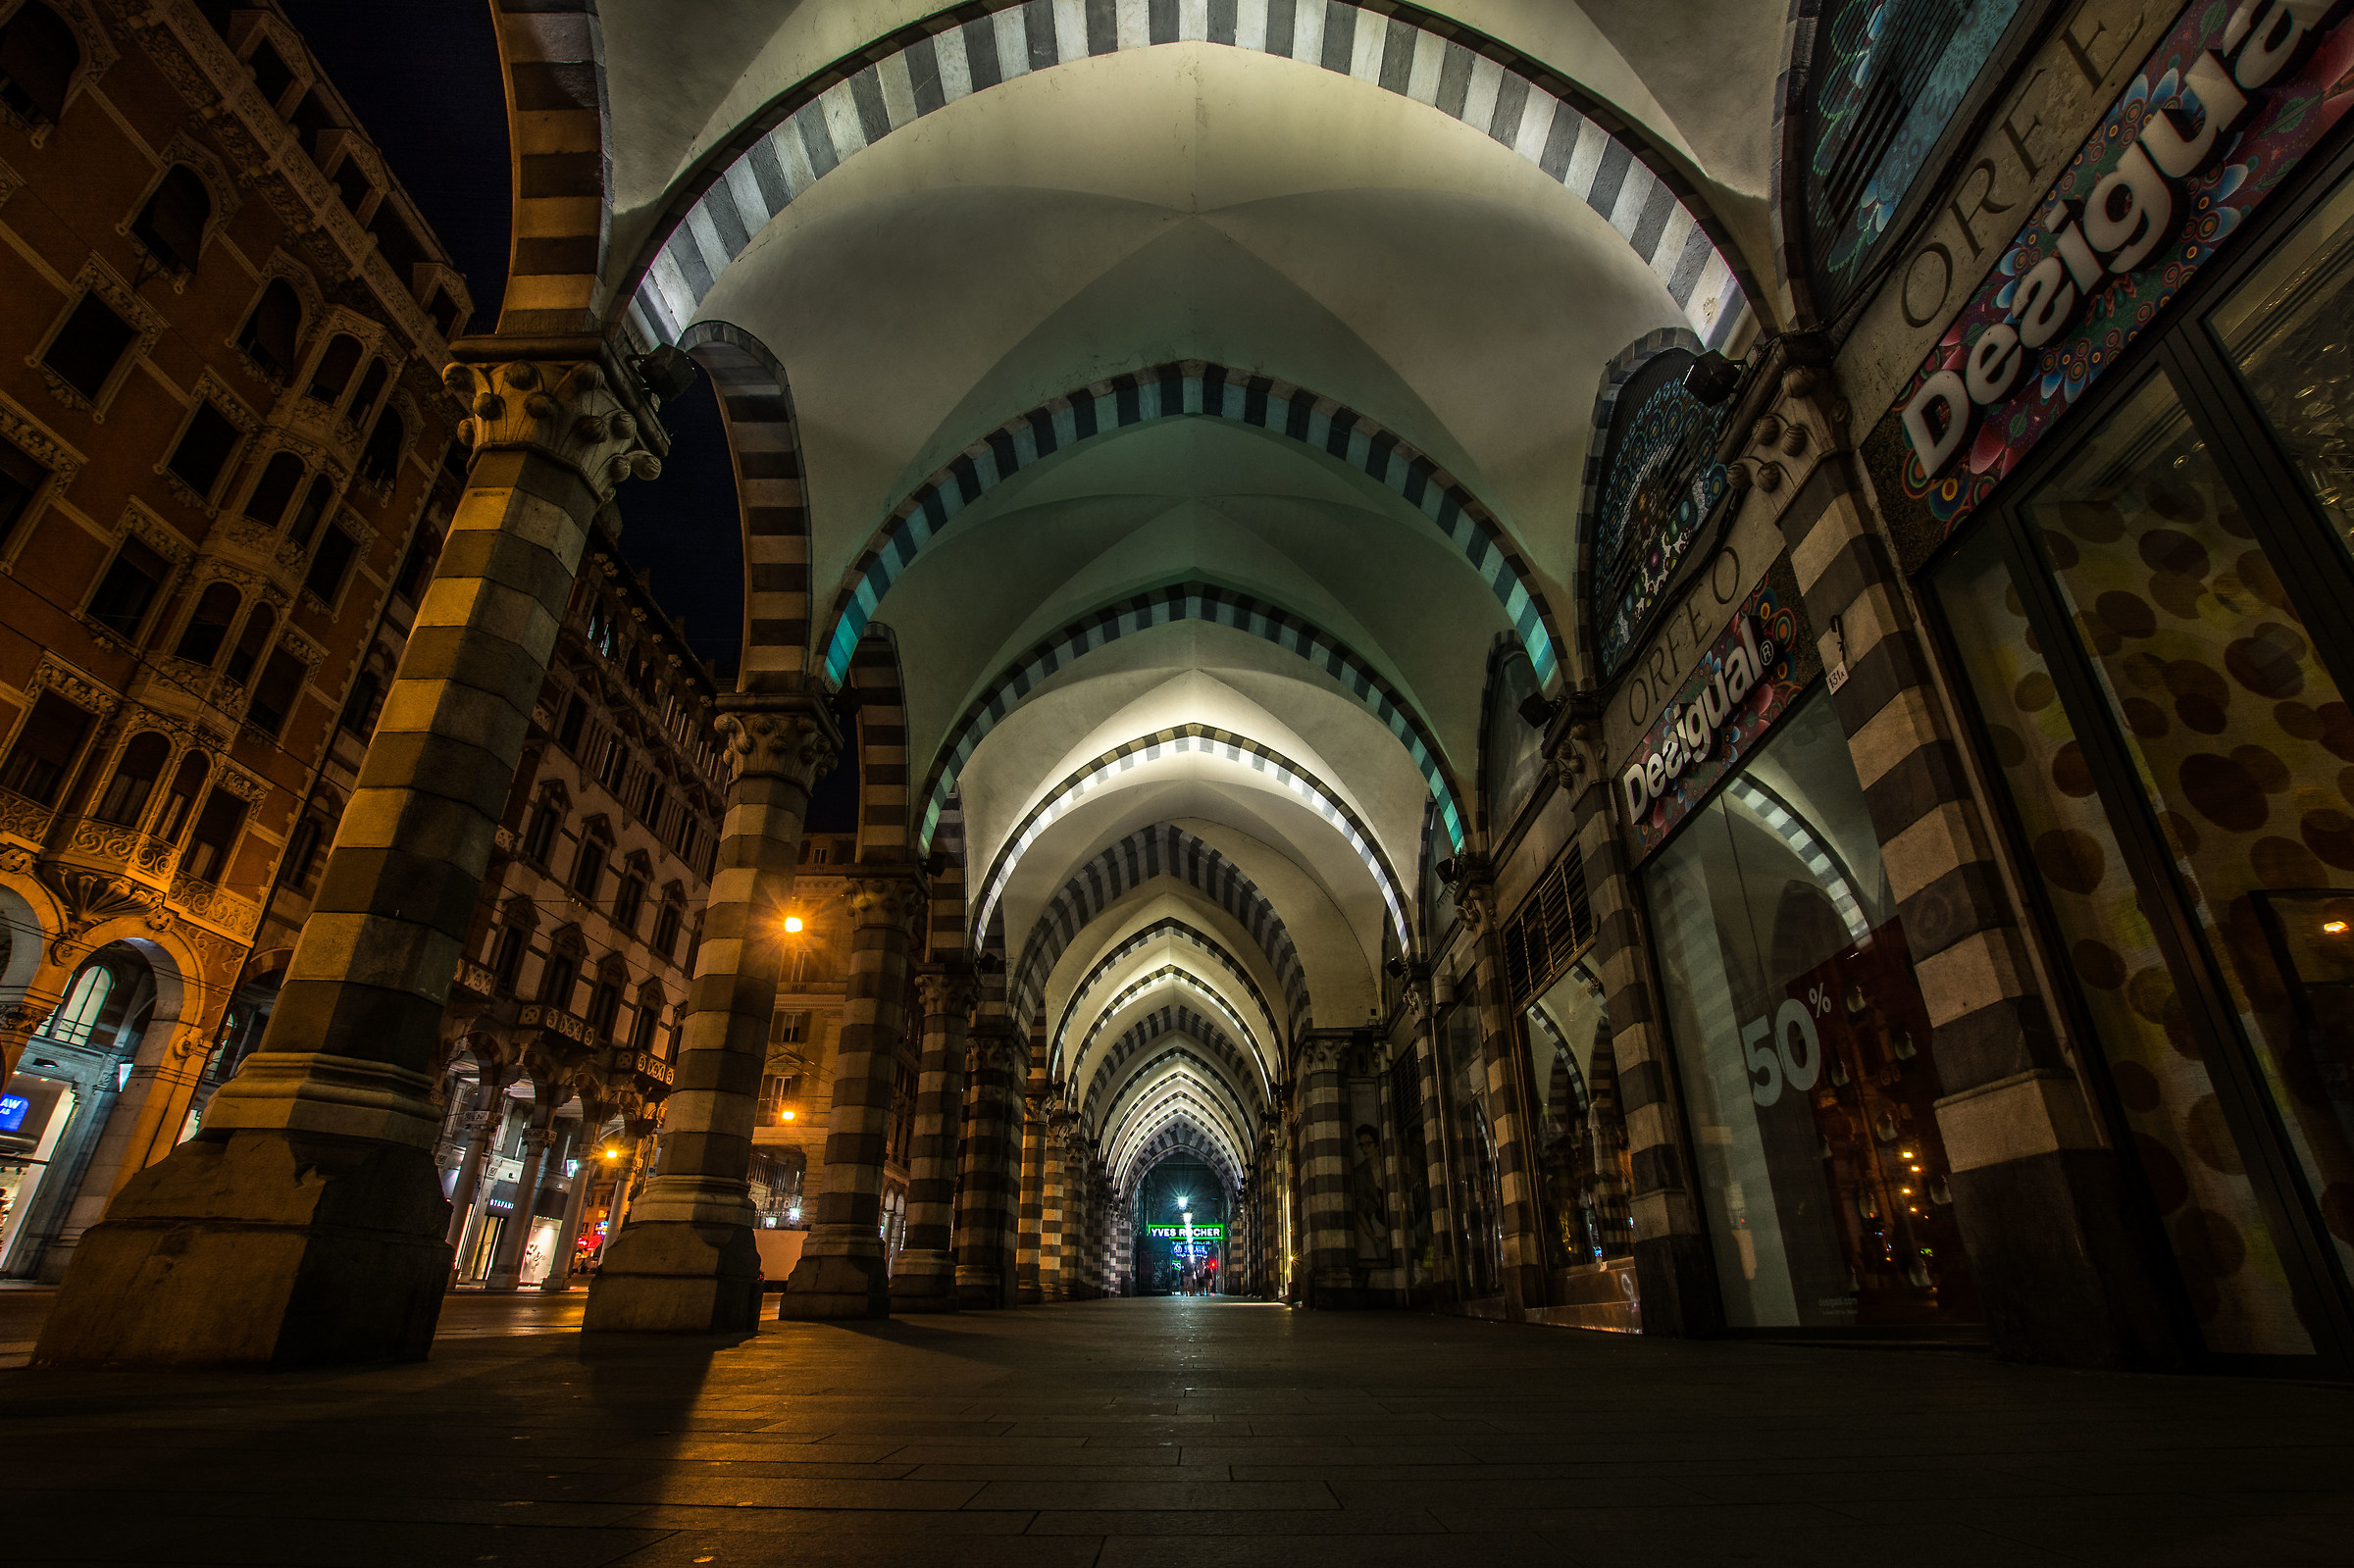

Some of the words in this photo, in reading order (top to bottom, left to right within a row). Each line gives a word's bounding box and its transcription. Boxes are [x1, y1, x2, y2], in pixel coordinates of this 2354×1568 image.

[1629, 546, 1740, 727] ORFEO
[1623, 615, 1766, 826] Desigual
[1741, 982, 1832, 1107] 50%
[1151, 1228, 1177, 1237] YVES
[1178, 1228, 1220, 1237] RCHER
